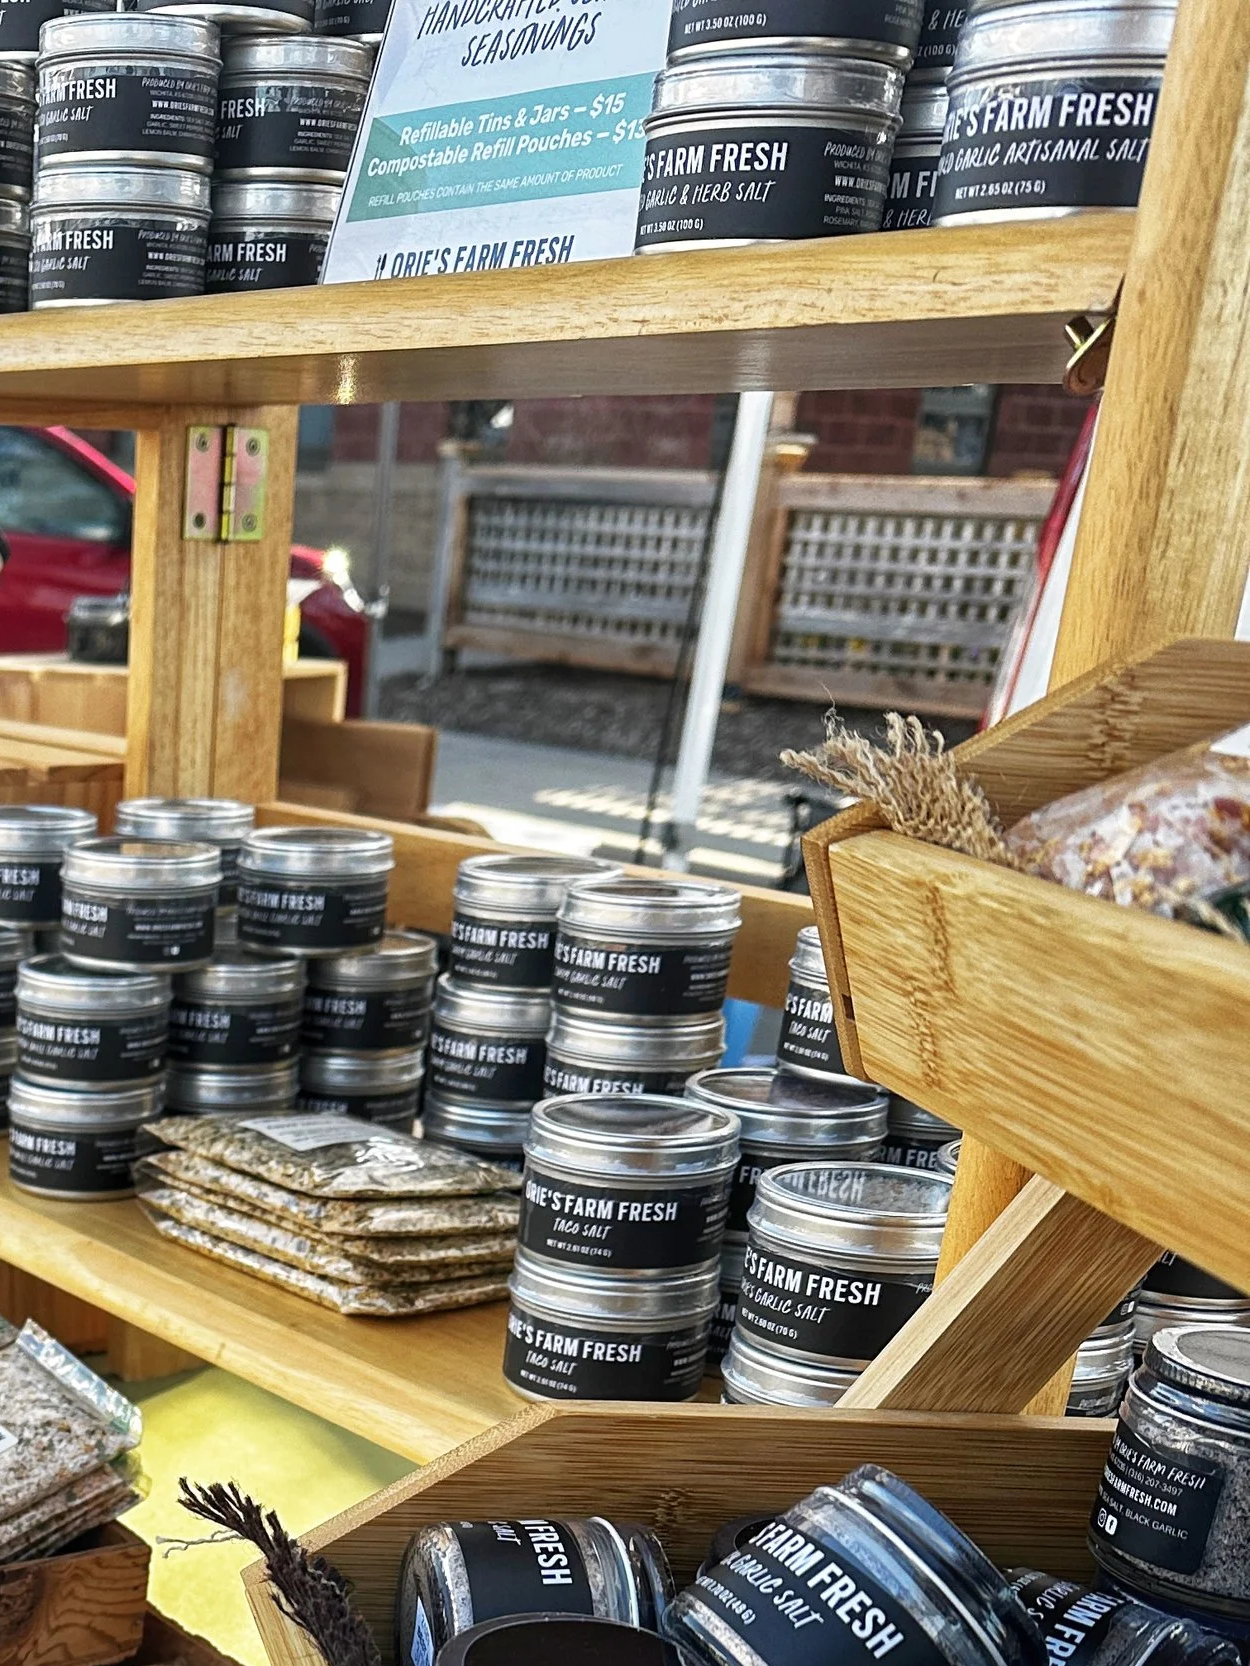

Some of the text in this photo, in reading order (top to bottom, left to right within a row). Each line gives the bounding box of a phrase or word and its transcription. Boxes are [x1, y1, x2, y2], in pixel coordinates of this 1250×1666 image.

[461, 12, 602, 66] SEASONINGS
[68, 78, 116, 100] FRESH
[70, 105, 94, 122] SALT
[220, 98, 267, 119] FRESH
[400, 92, 626, 146] Refillable Tins & Jars $15
[983, 92, 1153, 135] FARM FRESH
[367, 141, 468, 177] Compostable
[471, 136, 514, 160] Refill
[517, 127, 592, 156] Pouches
[656, 142, 789, 179] FARM FRESH
[954, 137, 1150, 173] GARLIC ARTISANAL SALT
[368, 164, 623, 207] REFILL POUCHES CONTAIN THE SAME AMOUNT OF PRODUCT
[644, 179, 776, 211] GARLIC & HERB SALT
[1002, 182, 1014, 194] OZ
[66, 230, 114, 250] FRESH
[67, 256, 90, 270] SALT
[237, 243, 287, 264] FRESH
[391, 235, 575, 278] ORIE'S FARM FRESH
[239, 268, 262, 283] SALT
[71, 904, 108, 922] FRESH
[281, 894, 325, 911] FRESH
[465, 925, 549, 949] FARM FRESH
[570, 949, 661, 974] FARM FRESH
[797, 998, 833, 1024] FARM
[56, 1026, 101, 1044] FRESH
[807, 1026, 831, 1044] SALT
[479, 1046, 528, 1064] FRESH
[36, 1137, 76, 1156] FRESH
[525, 1180, 562, 1210] ORIE'S
[563, 1194, 613, 1220] FARM
[617, 1201, 678, 1222] FRESH
[552, 1217, 613, 1241] TACO SALT
[757, 1259, 881, 1306] FARM FRESH
[754, 1287, 831, 1324] GARLIC SALT
[535, 1330, 642, 1363] FARM FRESH
[525, 1350, 577, 1376] TACO SALT
[1138, 1454, 1206, 1490] FARM FRESH
[1145, 1477, 1183, 1497] 207-3497
[1125, 1508, 1188, 1540] BLACK GARLIC
[525, 1526, 573, 1584] FRESH
[731, 1552, 825, 1629] GARLIC SALT
[759, 1524, 904, 1660] FARM FRESH
